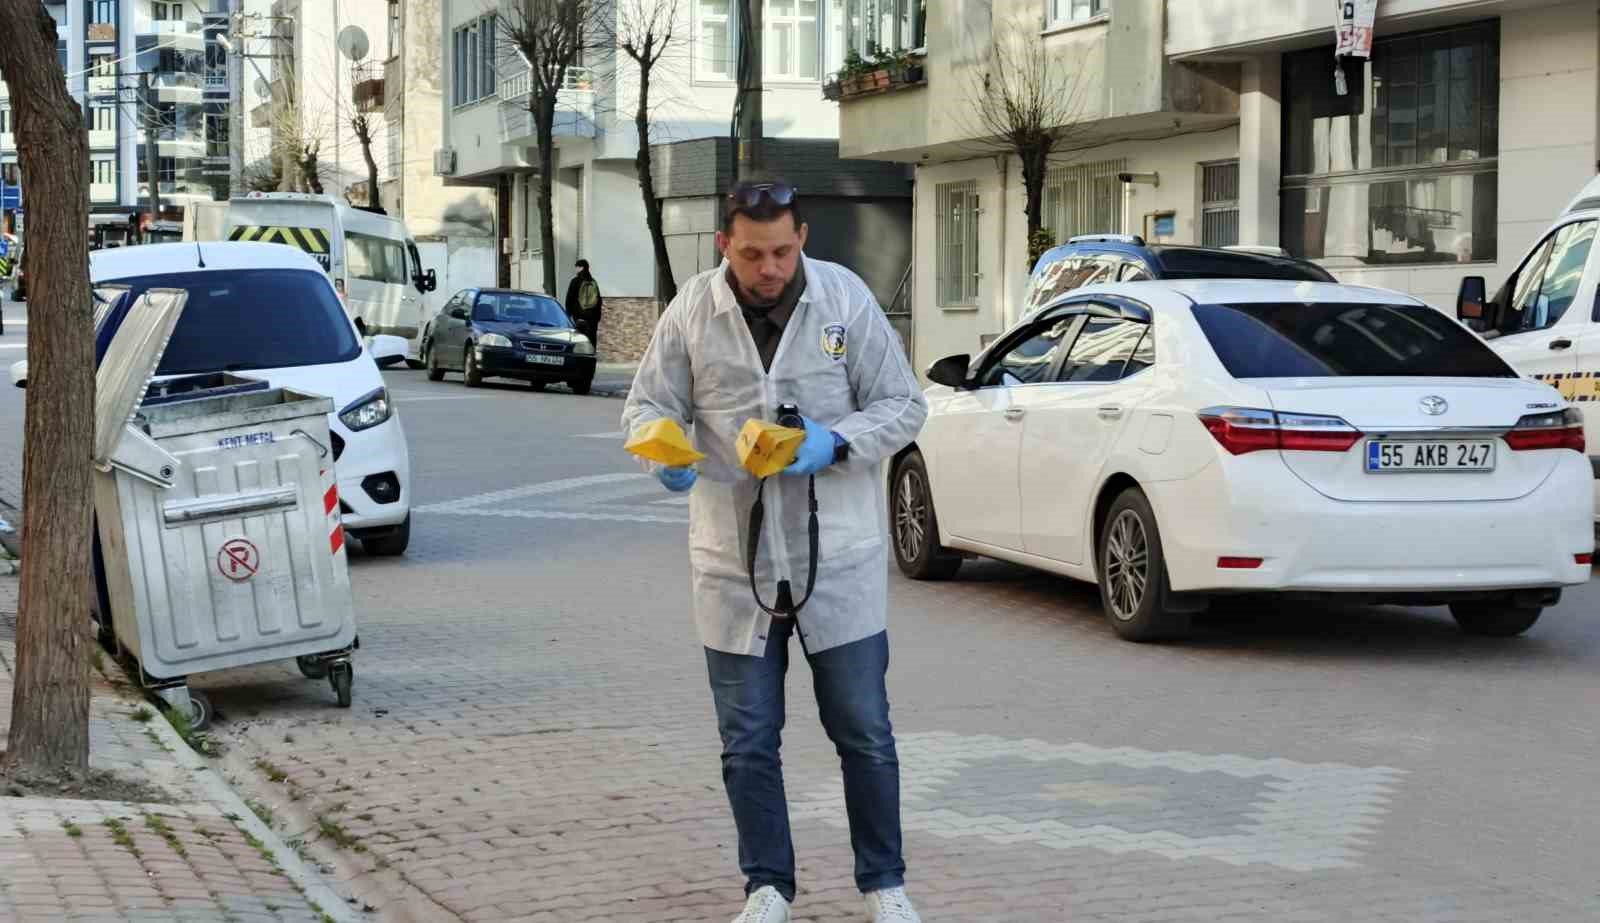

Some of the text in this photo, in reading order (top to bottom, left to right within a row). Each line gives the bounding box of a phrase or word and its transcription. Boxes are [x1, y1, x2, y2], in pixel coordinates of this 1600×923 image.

[1381, 444, 1490, 466] 55 AKB 247
